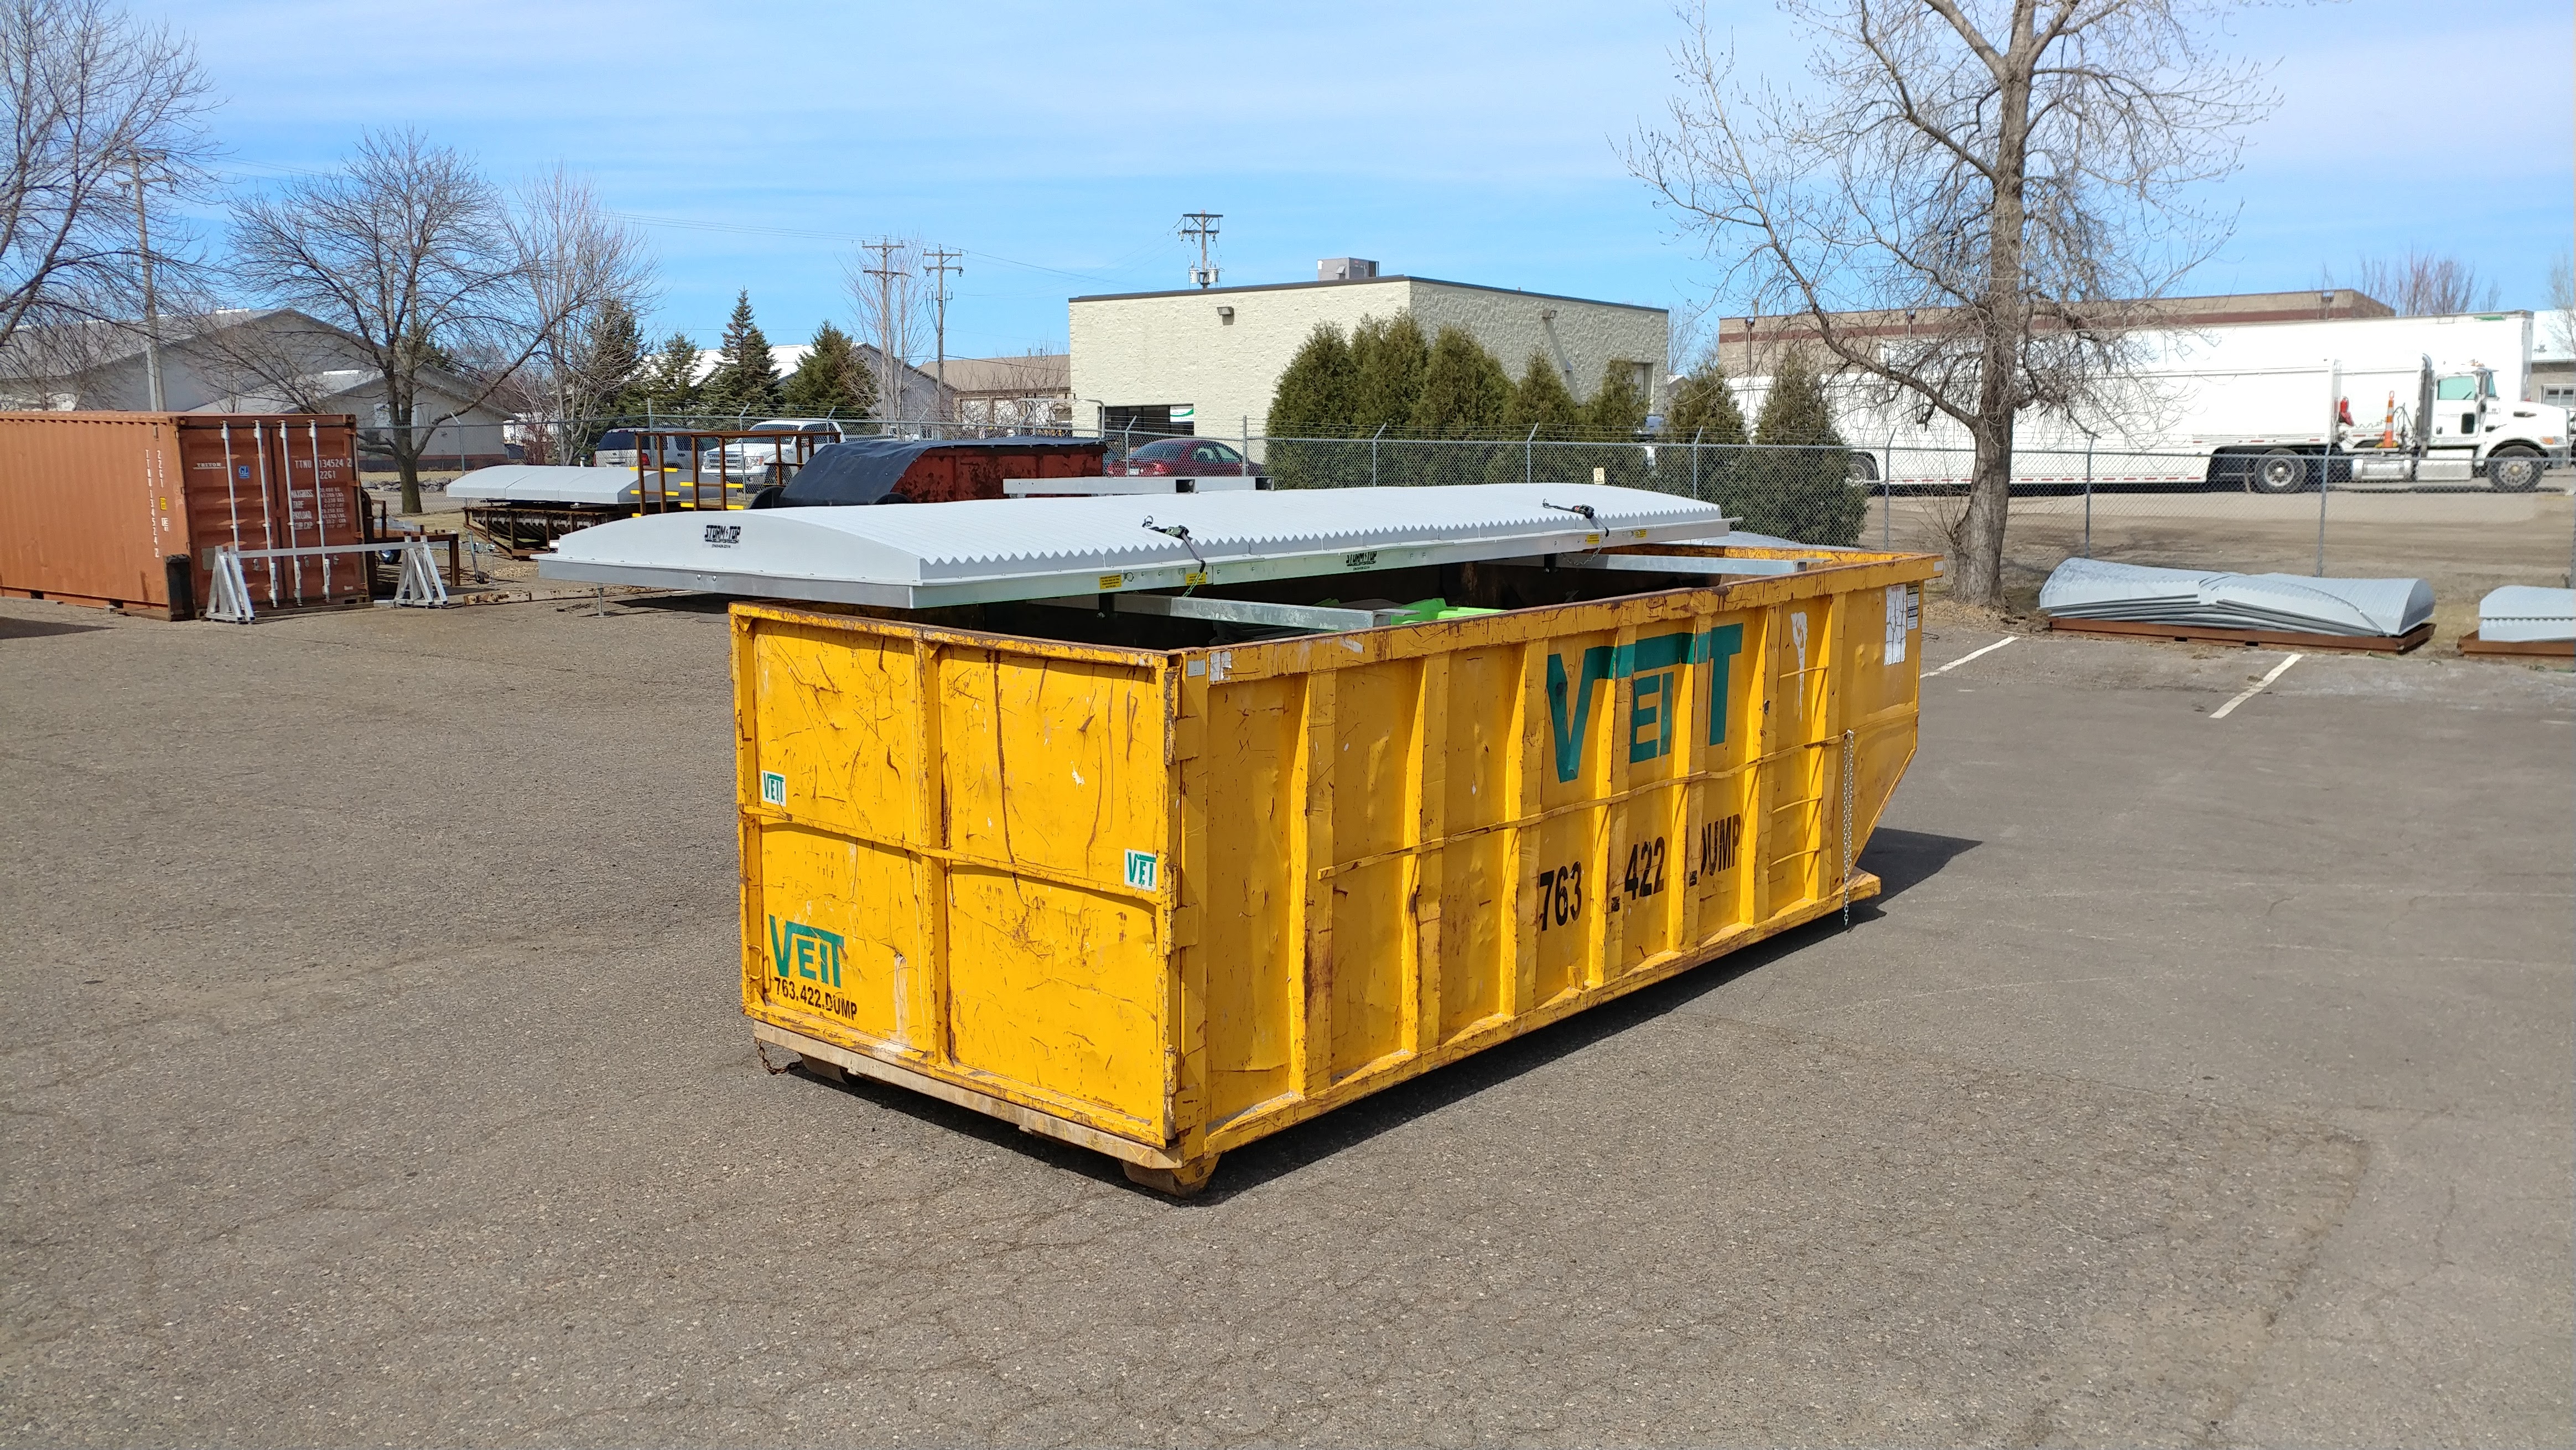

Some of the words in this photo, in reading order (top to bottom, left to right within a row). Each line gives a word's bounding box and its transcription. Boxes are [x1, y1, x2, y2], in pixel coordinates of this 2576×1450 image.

[238, 466, 249, 475] GL
[294, 460, 312, 469] TTNU
[319, 459, 344, 468] 134524
[320, 470, 336, 479] 22G1
[704, 525, 726, 540] STORM
[728, 526, 741, 540] TOP
[1346, 552, 1364, 565] STORM
[1367, 551, 1377, 561] TOP
[1546, 623, 1743, 783] VEIT
[763, 772, 784, 802] VEIT
[1128, 852, 1156, 887] VEI
[768, 913, 845, 989] VEIT
[774, 976, 858, 1021] 763.422.DUMP
